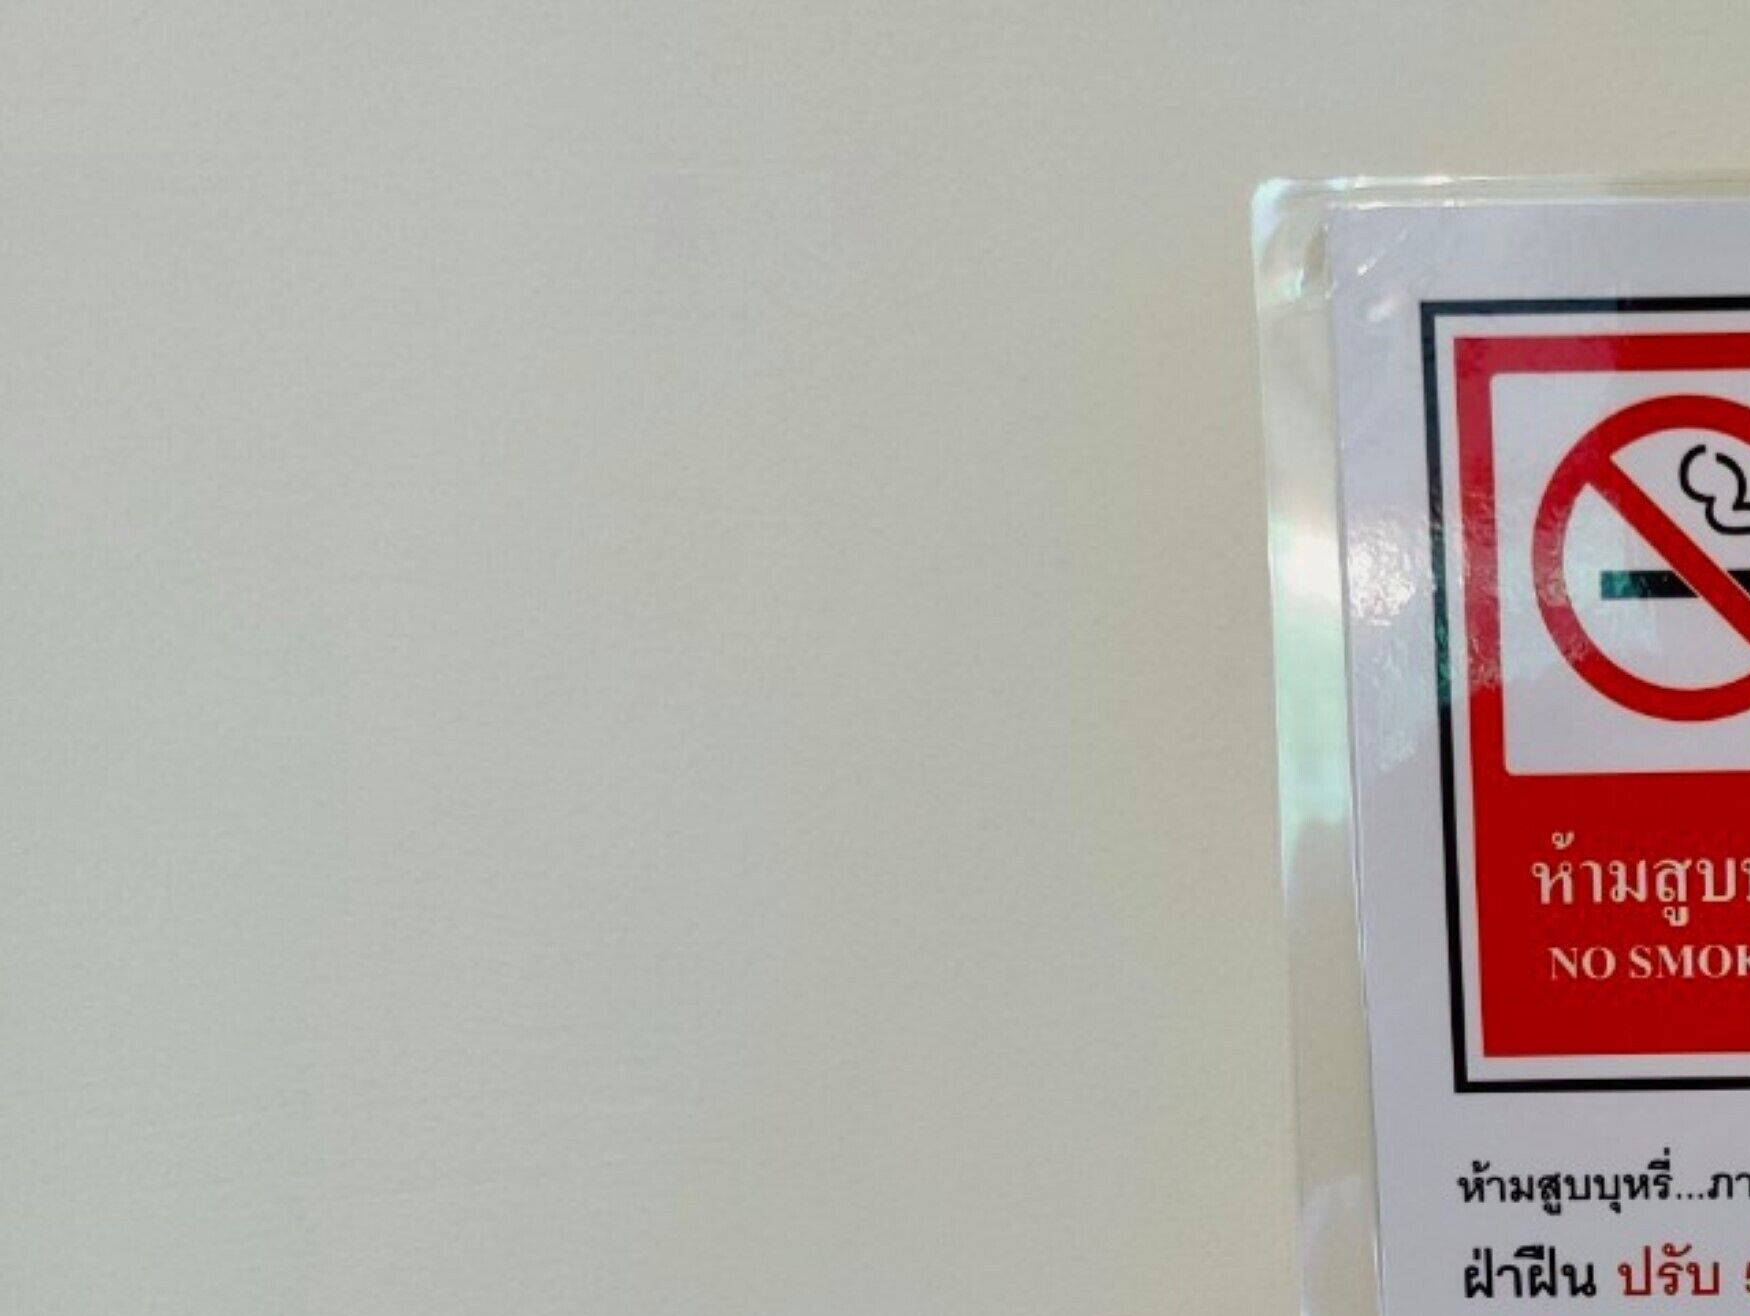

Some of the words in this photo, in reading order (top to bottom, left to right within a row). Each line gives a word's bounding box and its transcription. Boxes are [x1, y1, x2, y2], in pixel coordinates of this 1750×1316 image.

[1548, 946, 1617, 980] NO
[1464, 1244, 1597, 1299] ฝ่าฝืน
[1617, 1242, 1721, 1297] ปรับ
